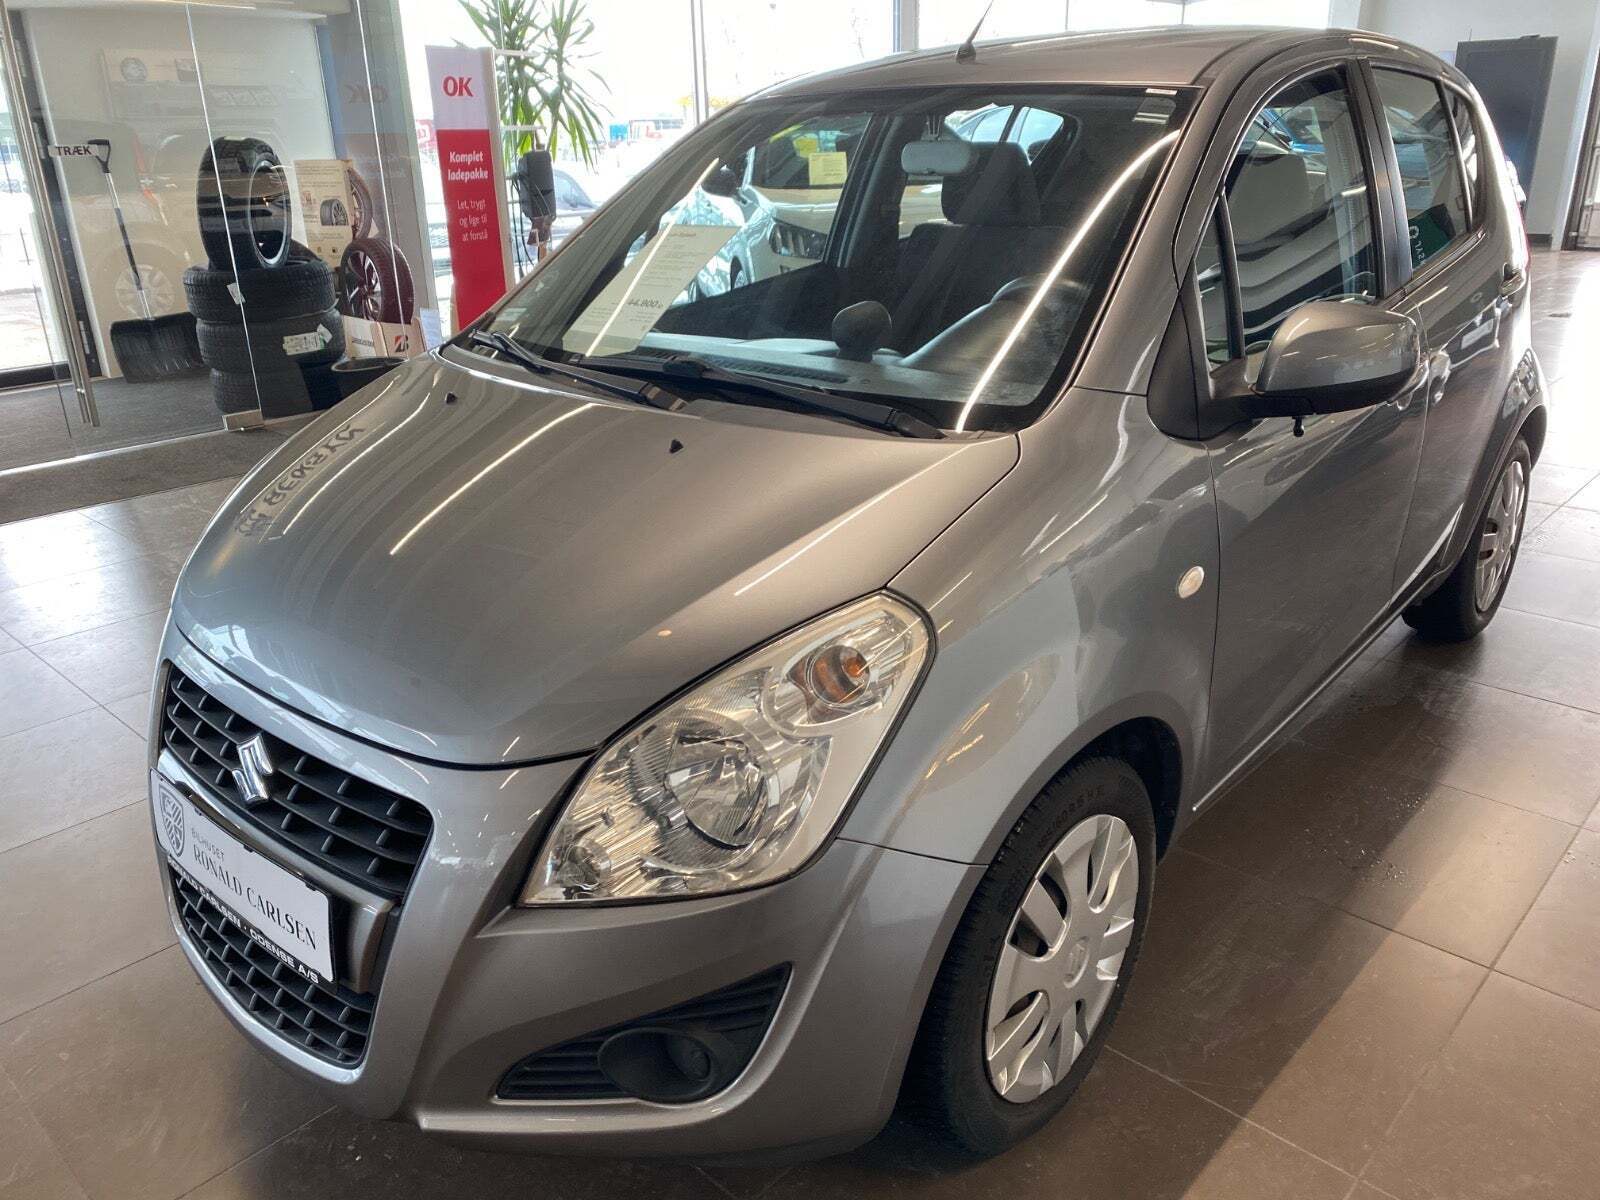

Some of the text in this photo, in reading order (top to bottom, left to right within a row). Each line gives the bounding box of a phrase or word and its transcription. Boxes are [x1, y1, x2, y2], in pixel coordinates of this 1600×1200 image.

[443, 76, 474, 97] OK
[55, 145, 92, 156] TRÆK
[449, 150, 484, 166] Komplet
[447, 168, 489, 183] ladepakke
[470, 199, 486, 211] trygt
[459, 216, 469, 227] og
[469, 214, 481, 227] lige
[470, 228, 488, 241] forstå
[192, 843, 242, 897] RONALD
[247, 887, 317, 950] CARLSEN
[250, 928, 296, 968] ODENSE
[298, 963, 320, 984] A/S
